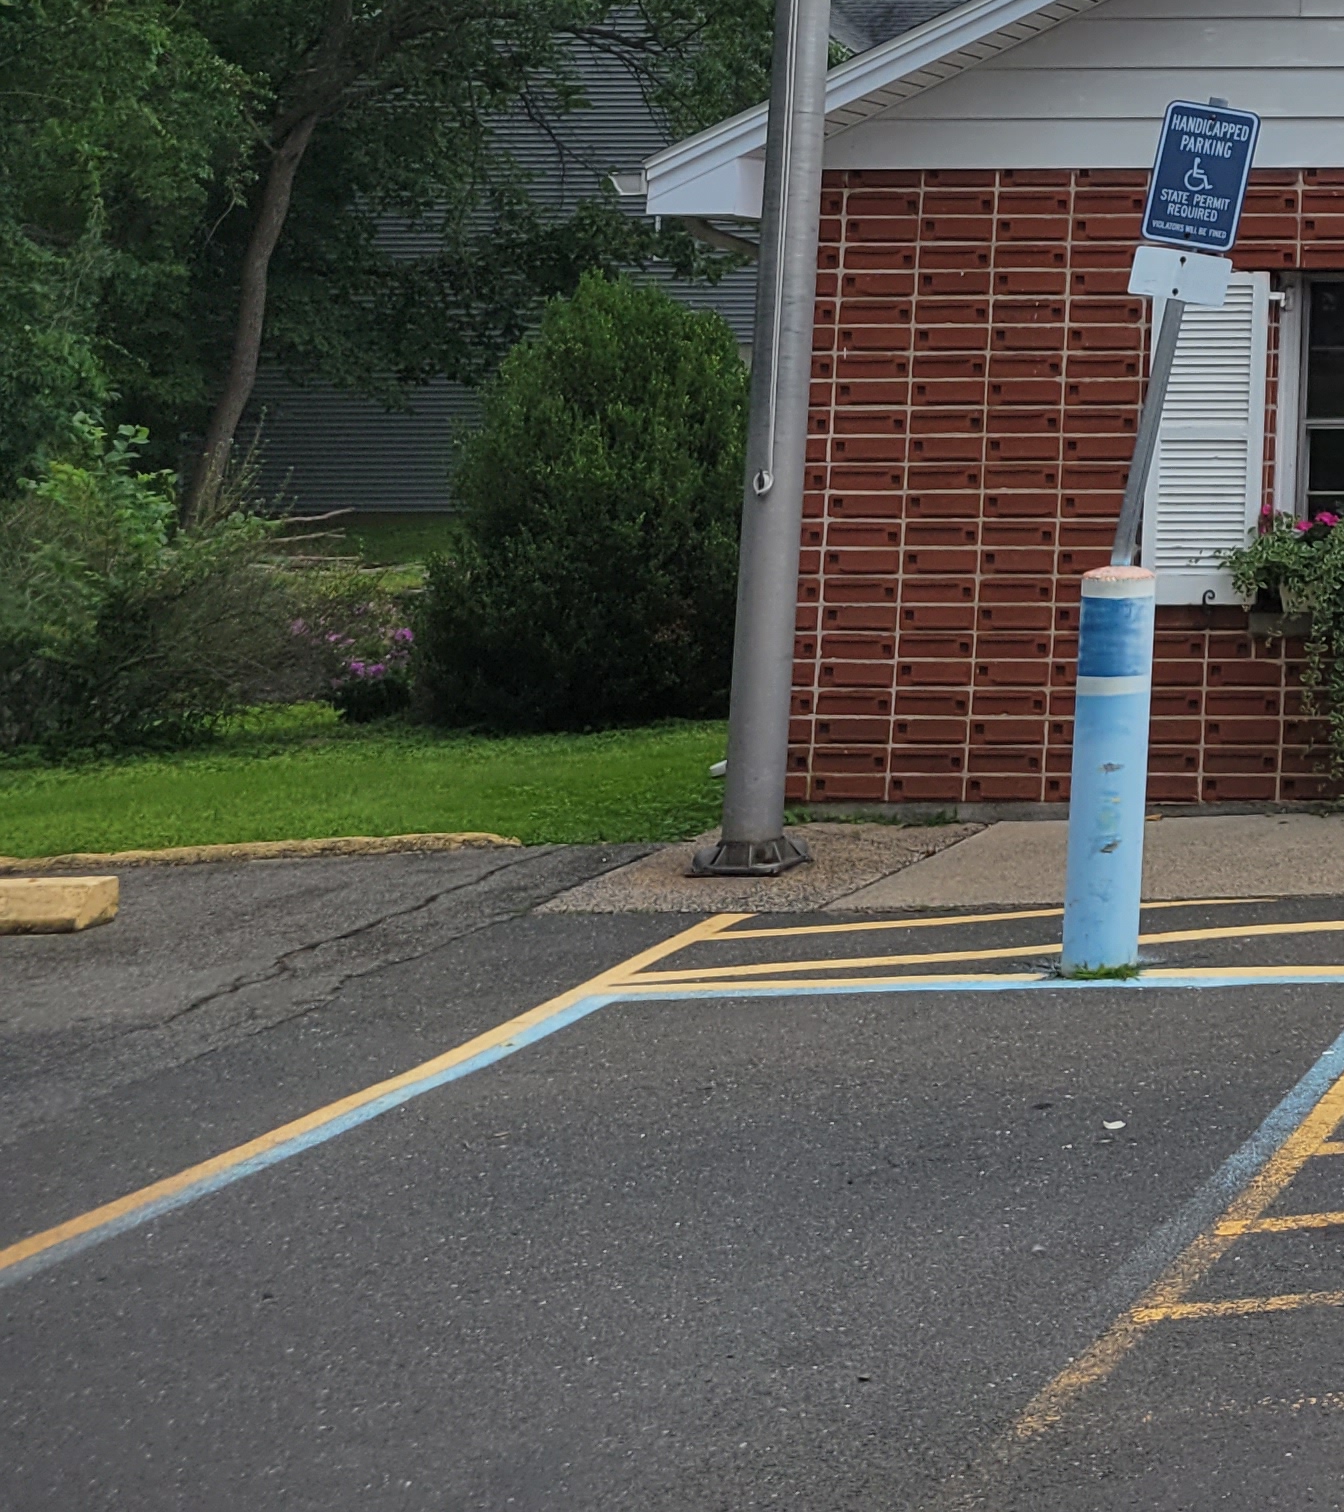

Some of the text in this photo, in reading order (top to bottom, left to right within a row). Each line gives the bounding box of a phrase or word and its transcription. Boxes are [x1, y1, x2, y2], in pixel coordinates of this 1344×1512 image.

[1171, 113, 1250, 142] HANDICAPPED
[1180, 134, 1233, 159] PARKING
[1160, 188, 1231, 211] STATE PERMIT
[1166, 202, 1218, 222] REQUIRED
[1152, 219, 1185, 233] VIOLATORS
[1208, 229, 1228, 239] FINED
